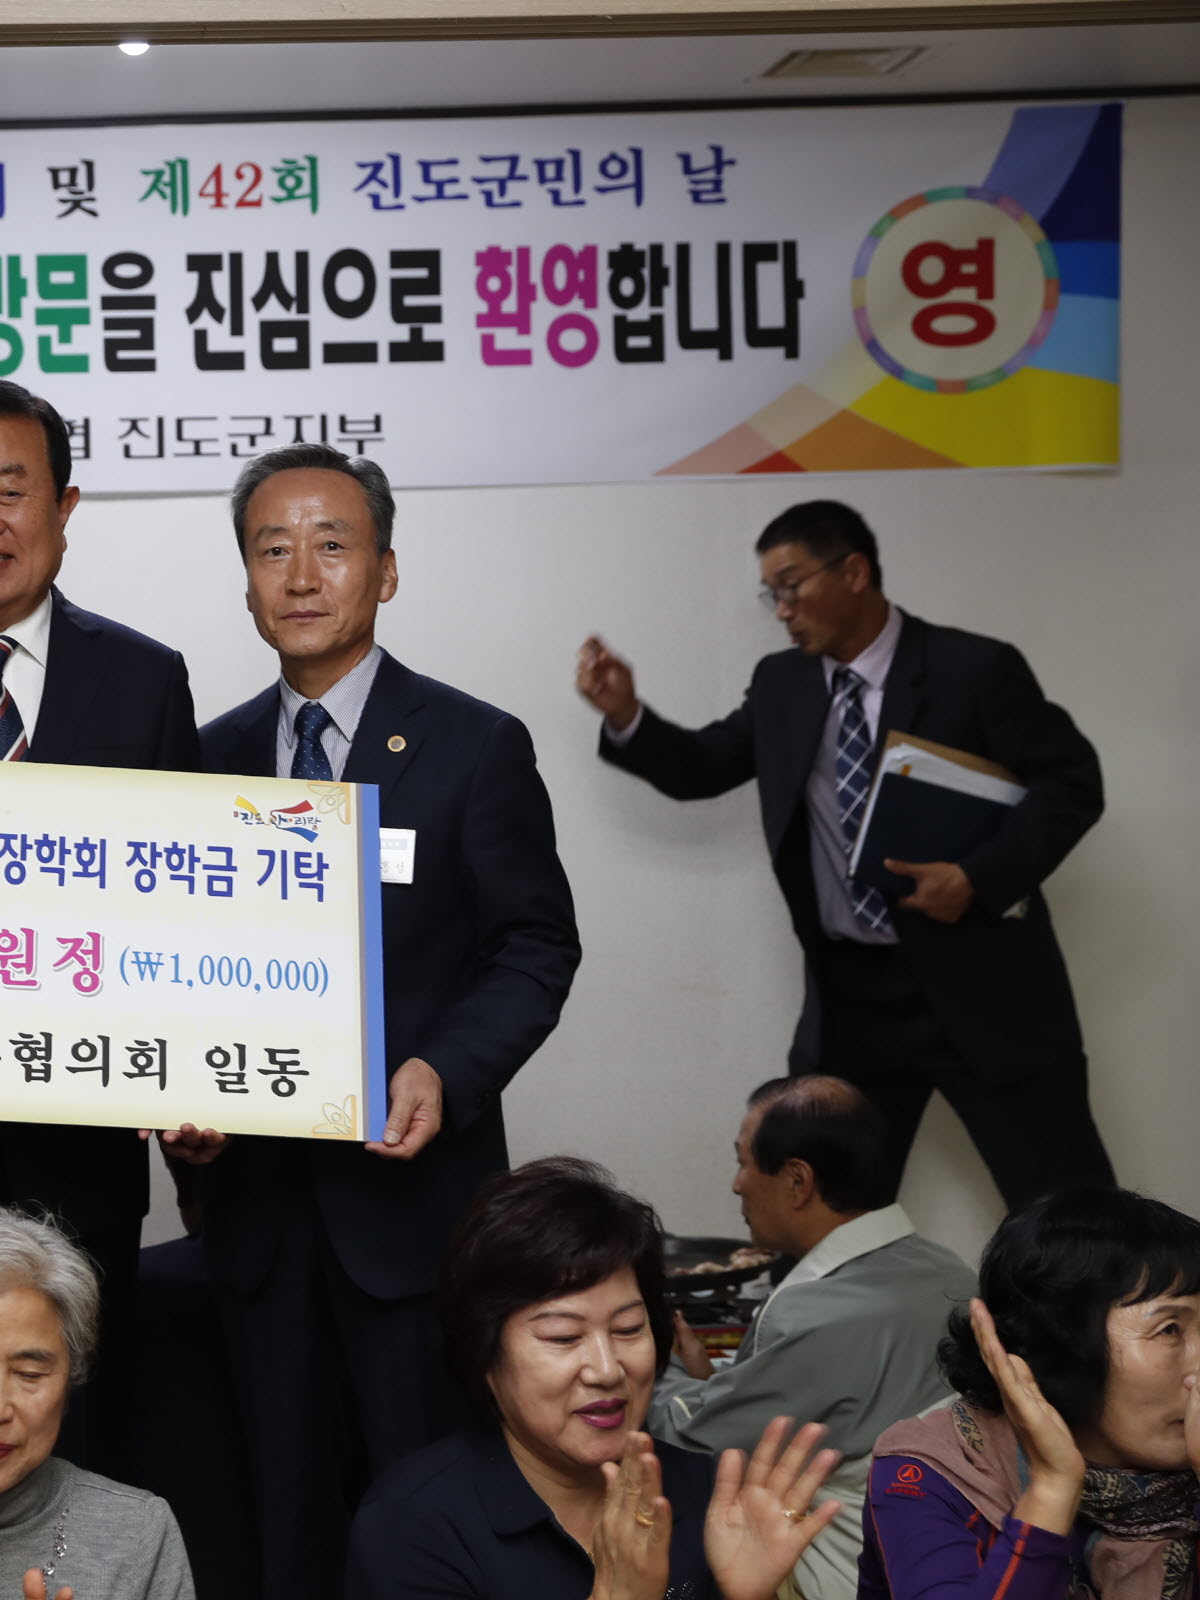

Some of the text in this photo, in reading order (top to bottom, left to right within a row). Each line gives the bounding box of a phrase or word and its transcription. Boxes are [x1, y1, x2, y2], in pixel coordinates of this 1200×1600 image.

[46, 157, 100, 219] 및
[137, 154, 321, 217] 제42회
[351, 144, 644, 211] 진도군민의
[675, 144, 738, 205] 날
[183, 246, 446, 372] 진심으로
[473, 238, 806, 368] 환영합니다
[900, 236, 997, 348] 영
[117, 412, 386, 461] 진도군지부
[125, 840, 238, 898] 장학금
[256, 848, 330, 903] 기탁
[204, 1042, 311, 1098] 일동
